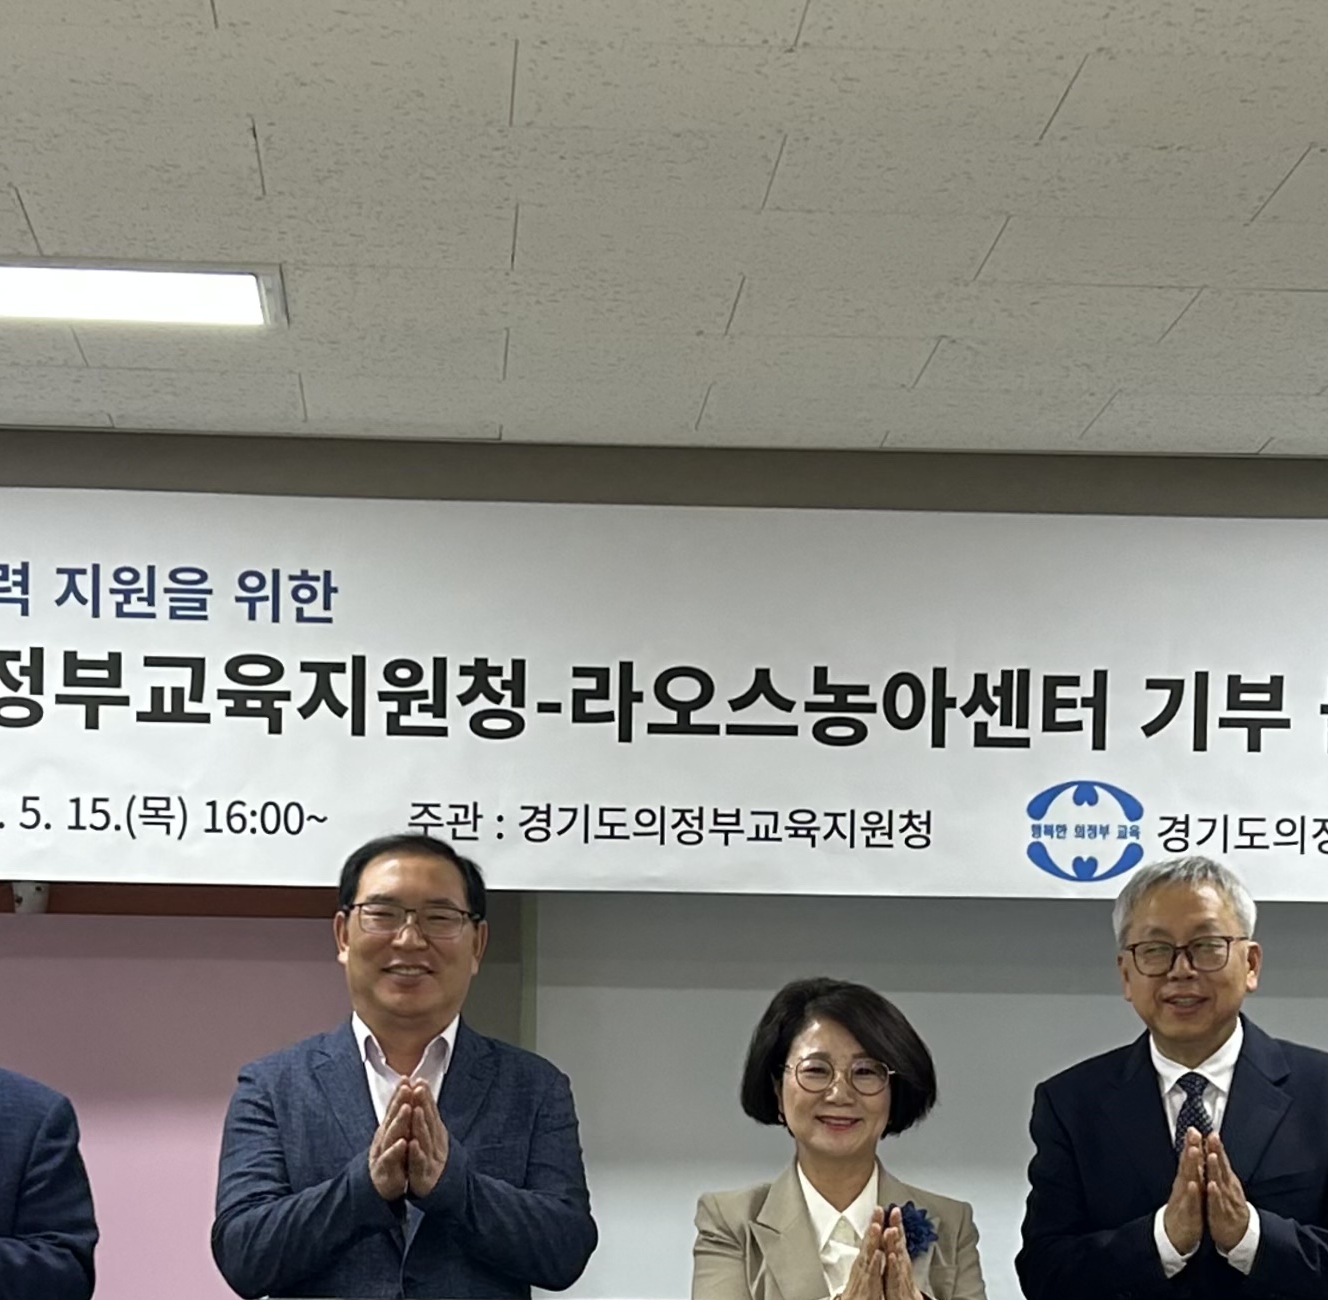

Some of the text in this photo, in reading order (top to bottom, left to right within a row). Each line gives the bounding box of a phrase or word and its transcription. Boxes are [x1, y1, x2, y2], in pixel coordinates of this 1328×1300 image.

[54, 562, 214, 622] 지원을
[234, 568, 339, 624] 위한
[1140, 670, 1292, 753] 기부
[19, 795, 52, 830] 5.
[203, 799, 328, 836] 16:00~
[407, 800, 932, 850] 주관 : 경기도의정부교육지원청
[1030, 823, 1141, 841] 행복한 의정부 교육
